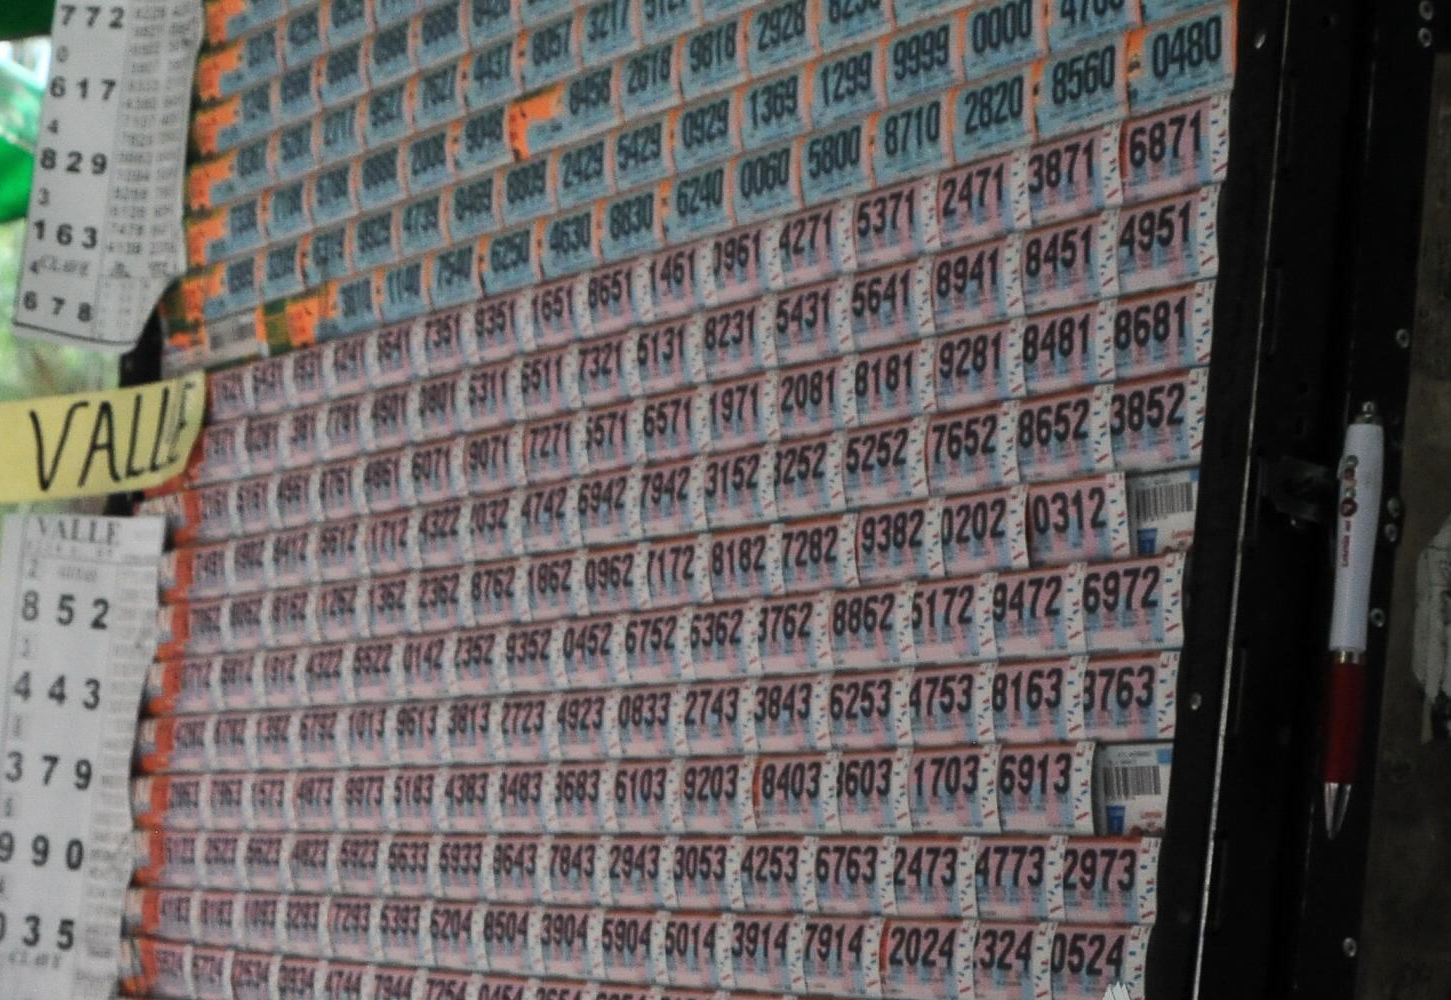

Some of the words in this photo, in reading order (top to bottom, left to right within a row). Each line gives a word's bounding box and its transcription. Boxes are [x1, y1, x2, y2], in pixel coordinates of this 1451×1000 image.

[894, 23, 950, 81] 9999
[1152, 15, 1222, 79] 0480
[822, 50, 872, 107] 1299
[1052, 45, 1115, 104] 8560
[964, 75, 1023, 135] 2820
[885, 101, 941, 156] 8710
[1129, 110, 1202, 168] 6871
[1028, 138, 1095, 194] 3871
[857, 188, 915, 238] 5371
[943, 163, 1004, 218] 2471
[778, 210, 833, 257] 4271
[1119, 201, 1191, 256] 4951
[937, 248, 998, 299] 8941
[1025, 225, 1092, 279] 8451
[705, 306, 755, 351] 8231
[776, 289, 831, 333] 5431
[1114, 295, 1186, 351] 8681
[939, 331, 1001, 379] 9281
[1023, 313, 1091, 364] 8481
[781, 367, 835, 413] 2081
[855, 353, 913, 397] 8181
[1018, 398, 1090, 449] 8652
[1110, 382, 1185, 436] 3852
[932, 414, 998, 474] 7652
[705, 453, 760, 498] 3152
[861, 509, 925, 554] 9382
[941, 497, 1006, 545] 0202
[1033, 487, 1107, 535] 0312
[712, 535, 766, 577] 8182
[782, 525, 838, 569] 7282
[911, 585, 975, 630] 5172
[993, 575, 1062, 622] 9472
[1083, 566, 1160, 615] 6972
[625, 615, 677, 655] 6752
[833, 593, 895, 637] 8862
[684, 687, 740, 728] 2743
[754, 682, 813, 722] 3843
[830, 679, 892, 720] 6253
[909, 673, 974, 718] 4753
[615, 767, 667, 801] 6103
[684, 764, 739, 801] 9203
[762, 762, 822, 799] 8403
[914, 755, 980, 798] 1703
[999, 753, 1071, 796] 6913
[742, 846, 798, 883] 4253
[815, 846, 878, 884] 6763
[894, 846, 958, 888] 2473
[975, 845, 1044, 888] 4773
[1062, 848, 1137, 894] 2973
[732, 922, 789, 959] 3914
[804, 923, 865, 963] 7914
[889, 927, 957, 972] 2024
[1052, 932, 1125, 983] 0524
